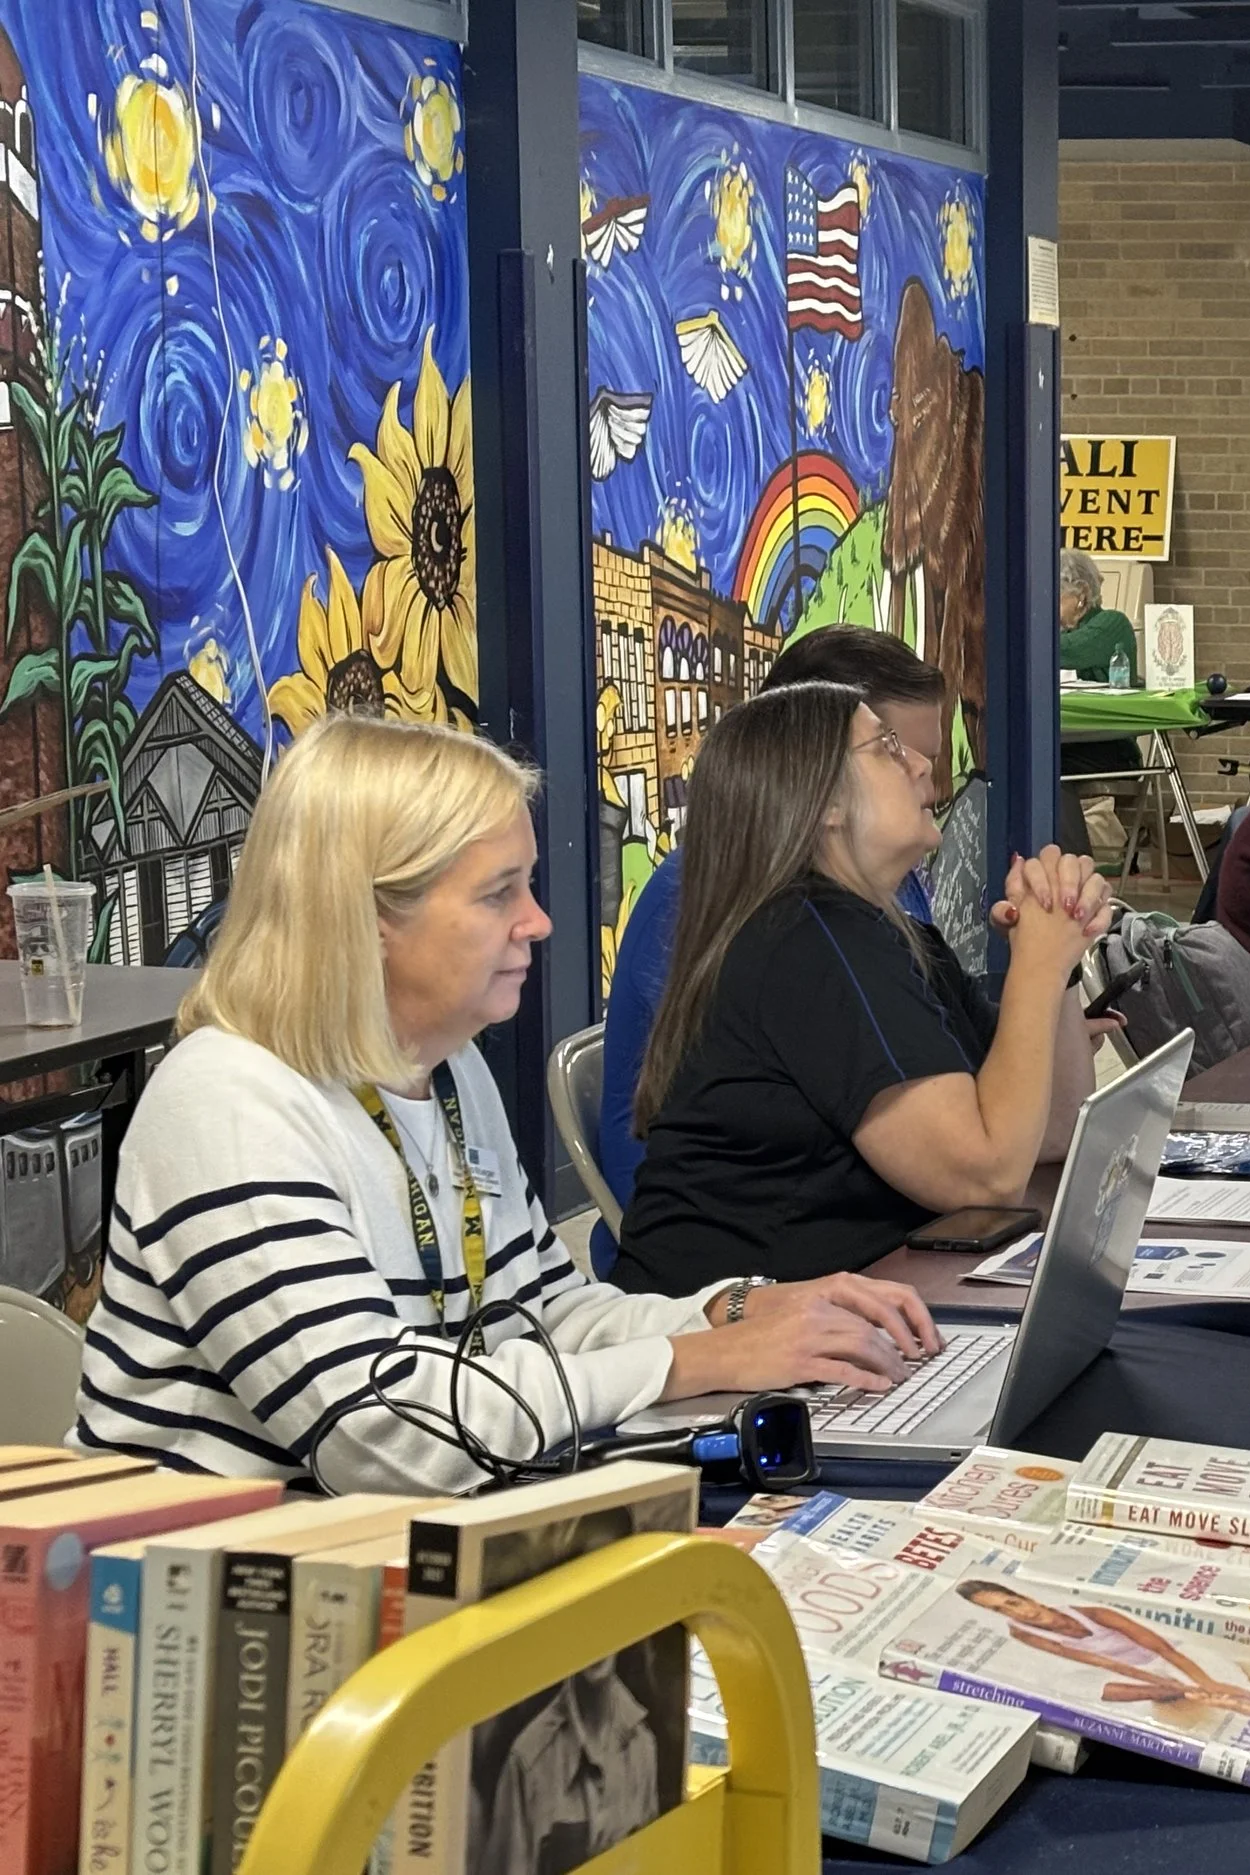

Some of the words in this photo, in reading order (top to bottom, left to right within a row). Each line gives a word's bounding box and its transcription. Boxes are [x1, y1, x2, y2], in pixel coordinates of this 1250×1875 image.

[1136, 1461, 1192, 1490] EAT
[1128, 1505, 1160, 1524] EAT
[1169, 1507, 1220, 1533] MOVE
[234, 1619, 270, 1712] JODI
[148, 1623, 182, 1777] SHERRYL
[1074, 1717, 1126, 1741] SUZANNE
